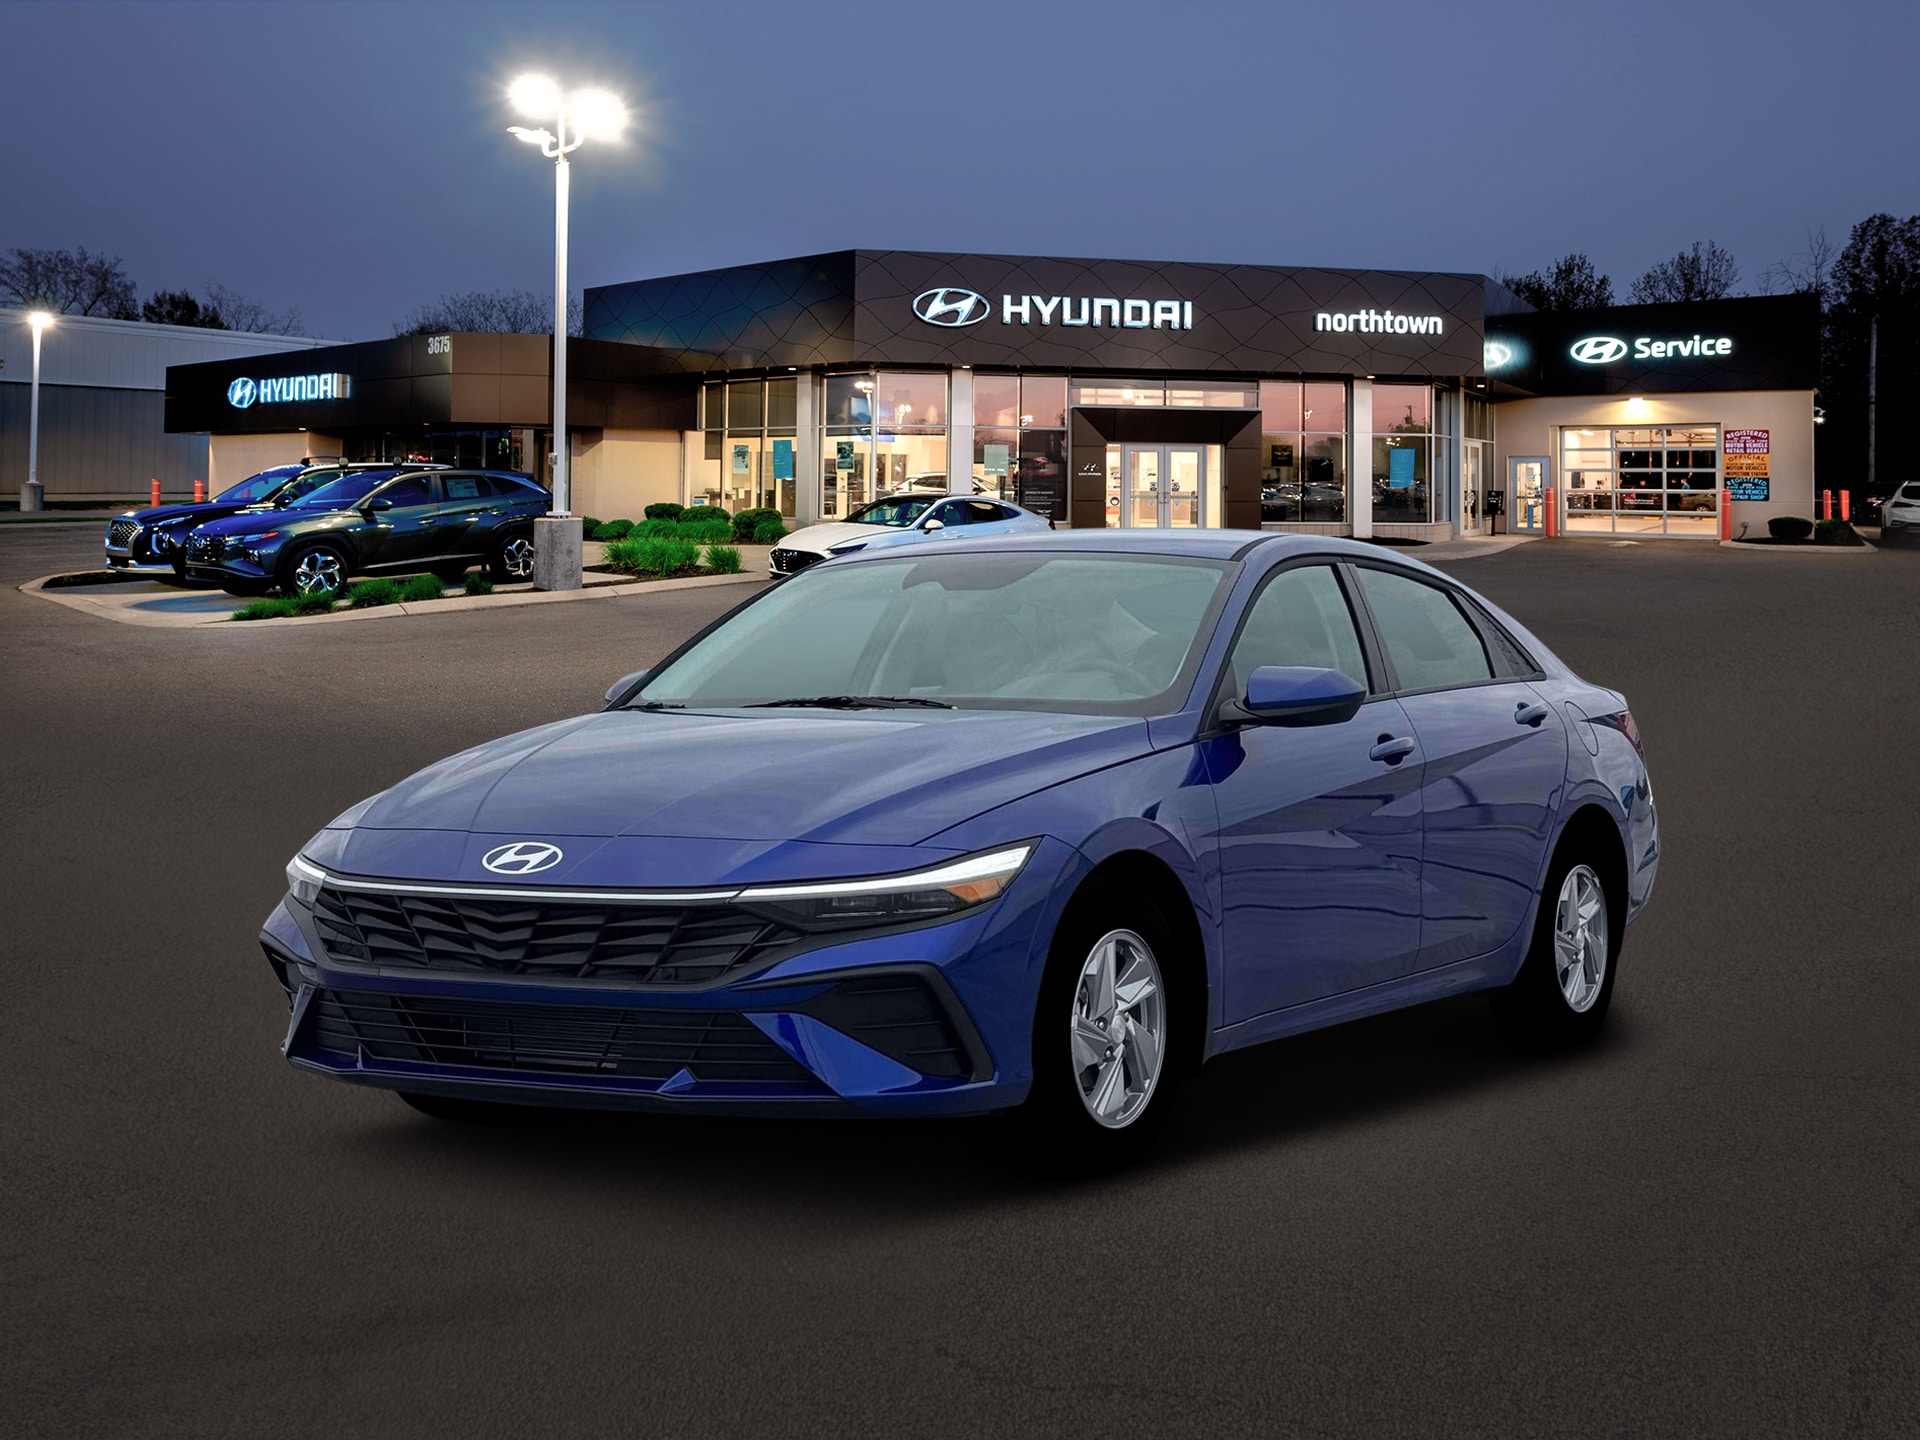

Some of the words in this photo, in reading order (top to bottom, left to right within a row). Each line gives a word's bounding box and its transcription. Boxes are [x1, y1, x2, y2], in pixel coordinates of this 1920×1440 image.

[1002, 294, 1193, 330] HYUNDAI
[1316, 309, 1443, 335] northtown
[427, 335, 450, 355] 3675
[1634, 334, 1732, 359] Service
[259, 372, 350, 403] HYUNDAI
[1726, 430, 1768, 439] REGISTERED
[1728, 454, 1766, 462] OFFICIAL
[1726, 477, 1767, 486] REGISTERED
